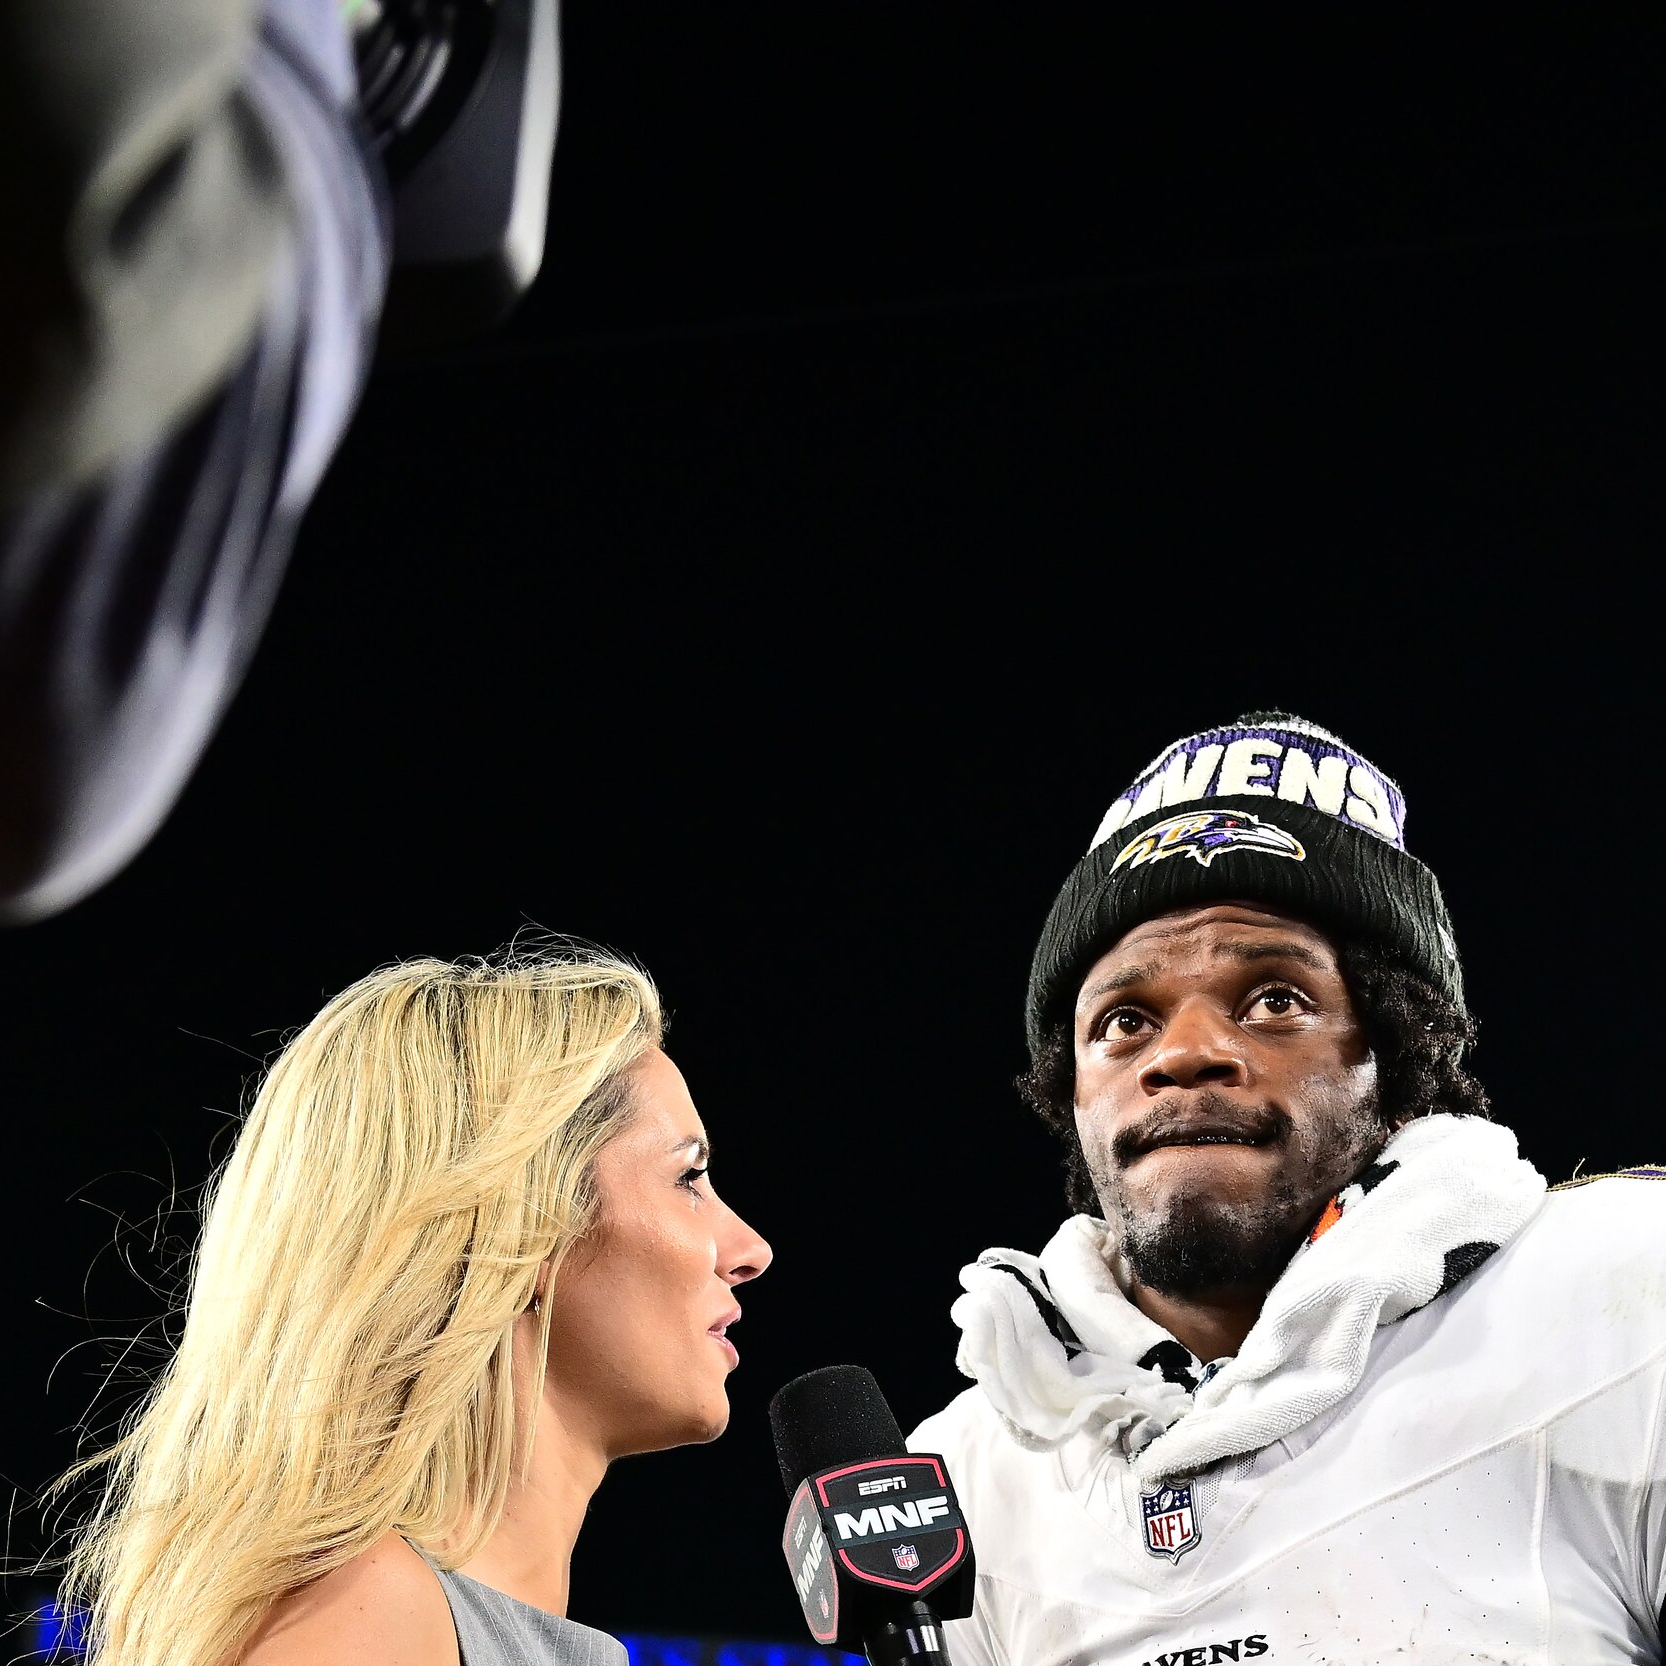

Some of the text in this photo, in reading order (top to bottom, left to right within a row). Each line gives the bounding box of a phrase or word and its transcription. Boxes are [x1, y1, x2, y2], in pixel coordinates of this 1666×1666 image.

[858, 1476, 907, 1496] ESPN
[834, 1496, 950, 1540] MNF
[1149, 1512, 1193, 1550] NFL
[797, 1523, 824, 1603] MNF
[898, 1554, 917, 1568] NFL
